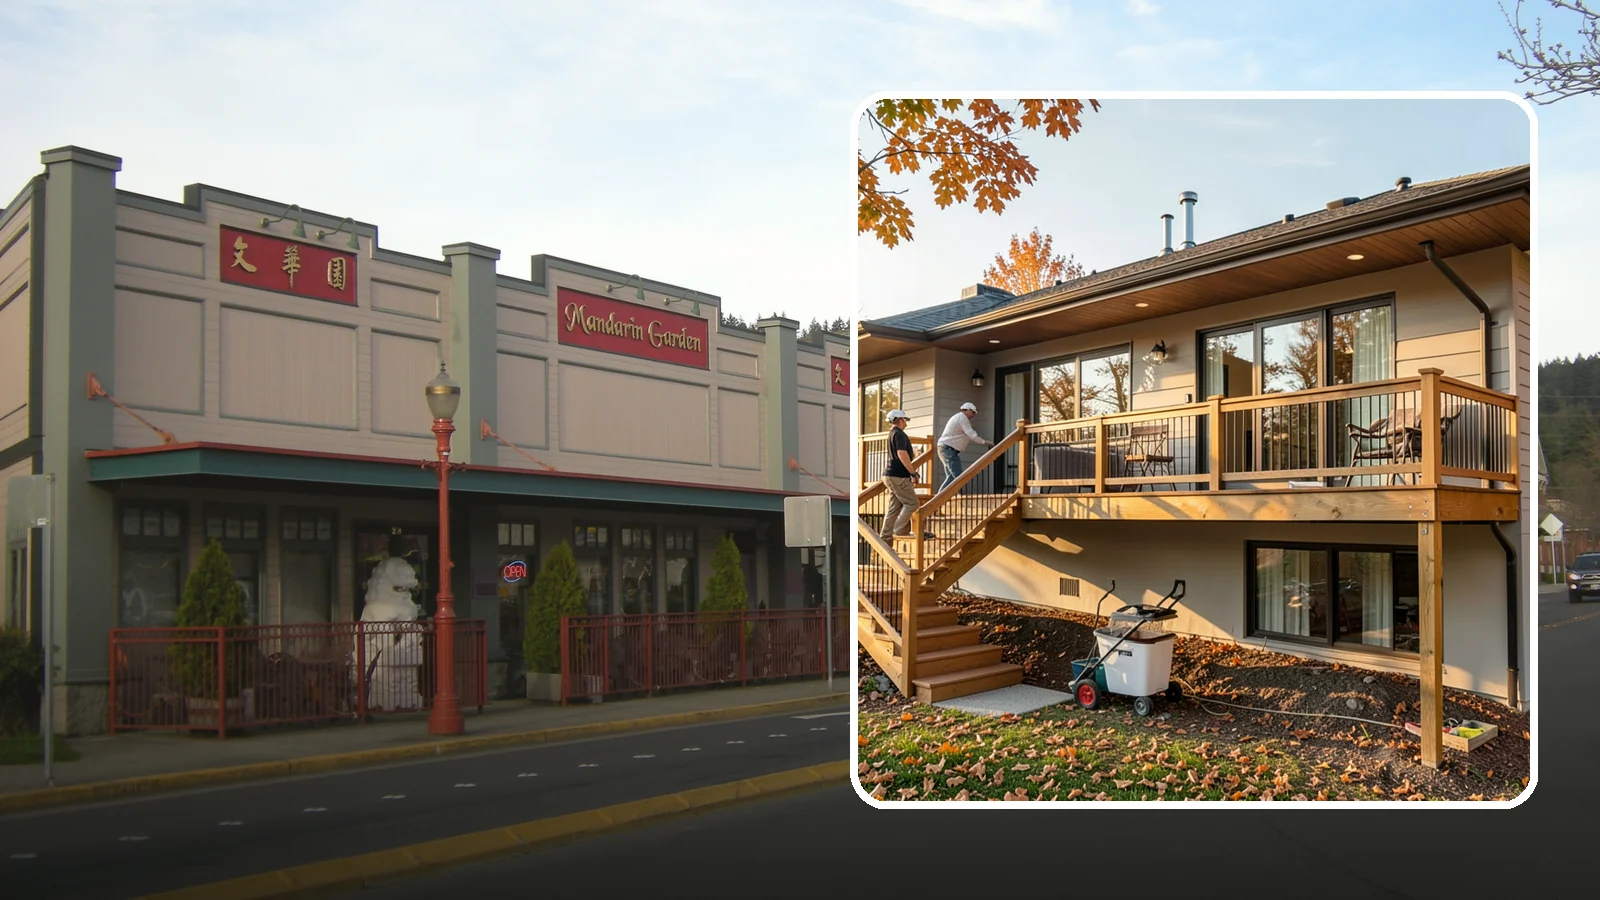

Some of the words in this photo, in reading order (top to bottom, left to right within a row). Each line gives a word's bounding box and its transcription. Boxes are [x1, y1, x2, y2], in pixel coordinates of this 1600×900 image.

[231, 236, 346, 290] 文華園
[564, 302, 644, 340] Mandarin
[648, 320, 702, 352] Garden
[503, 565, 527, 578] OPEN
